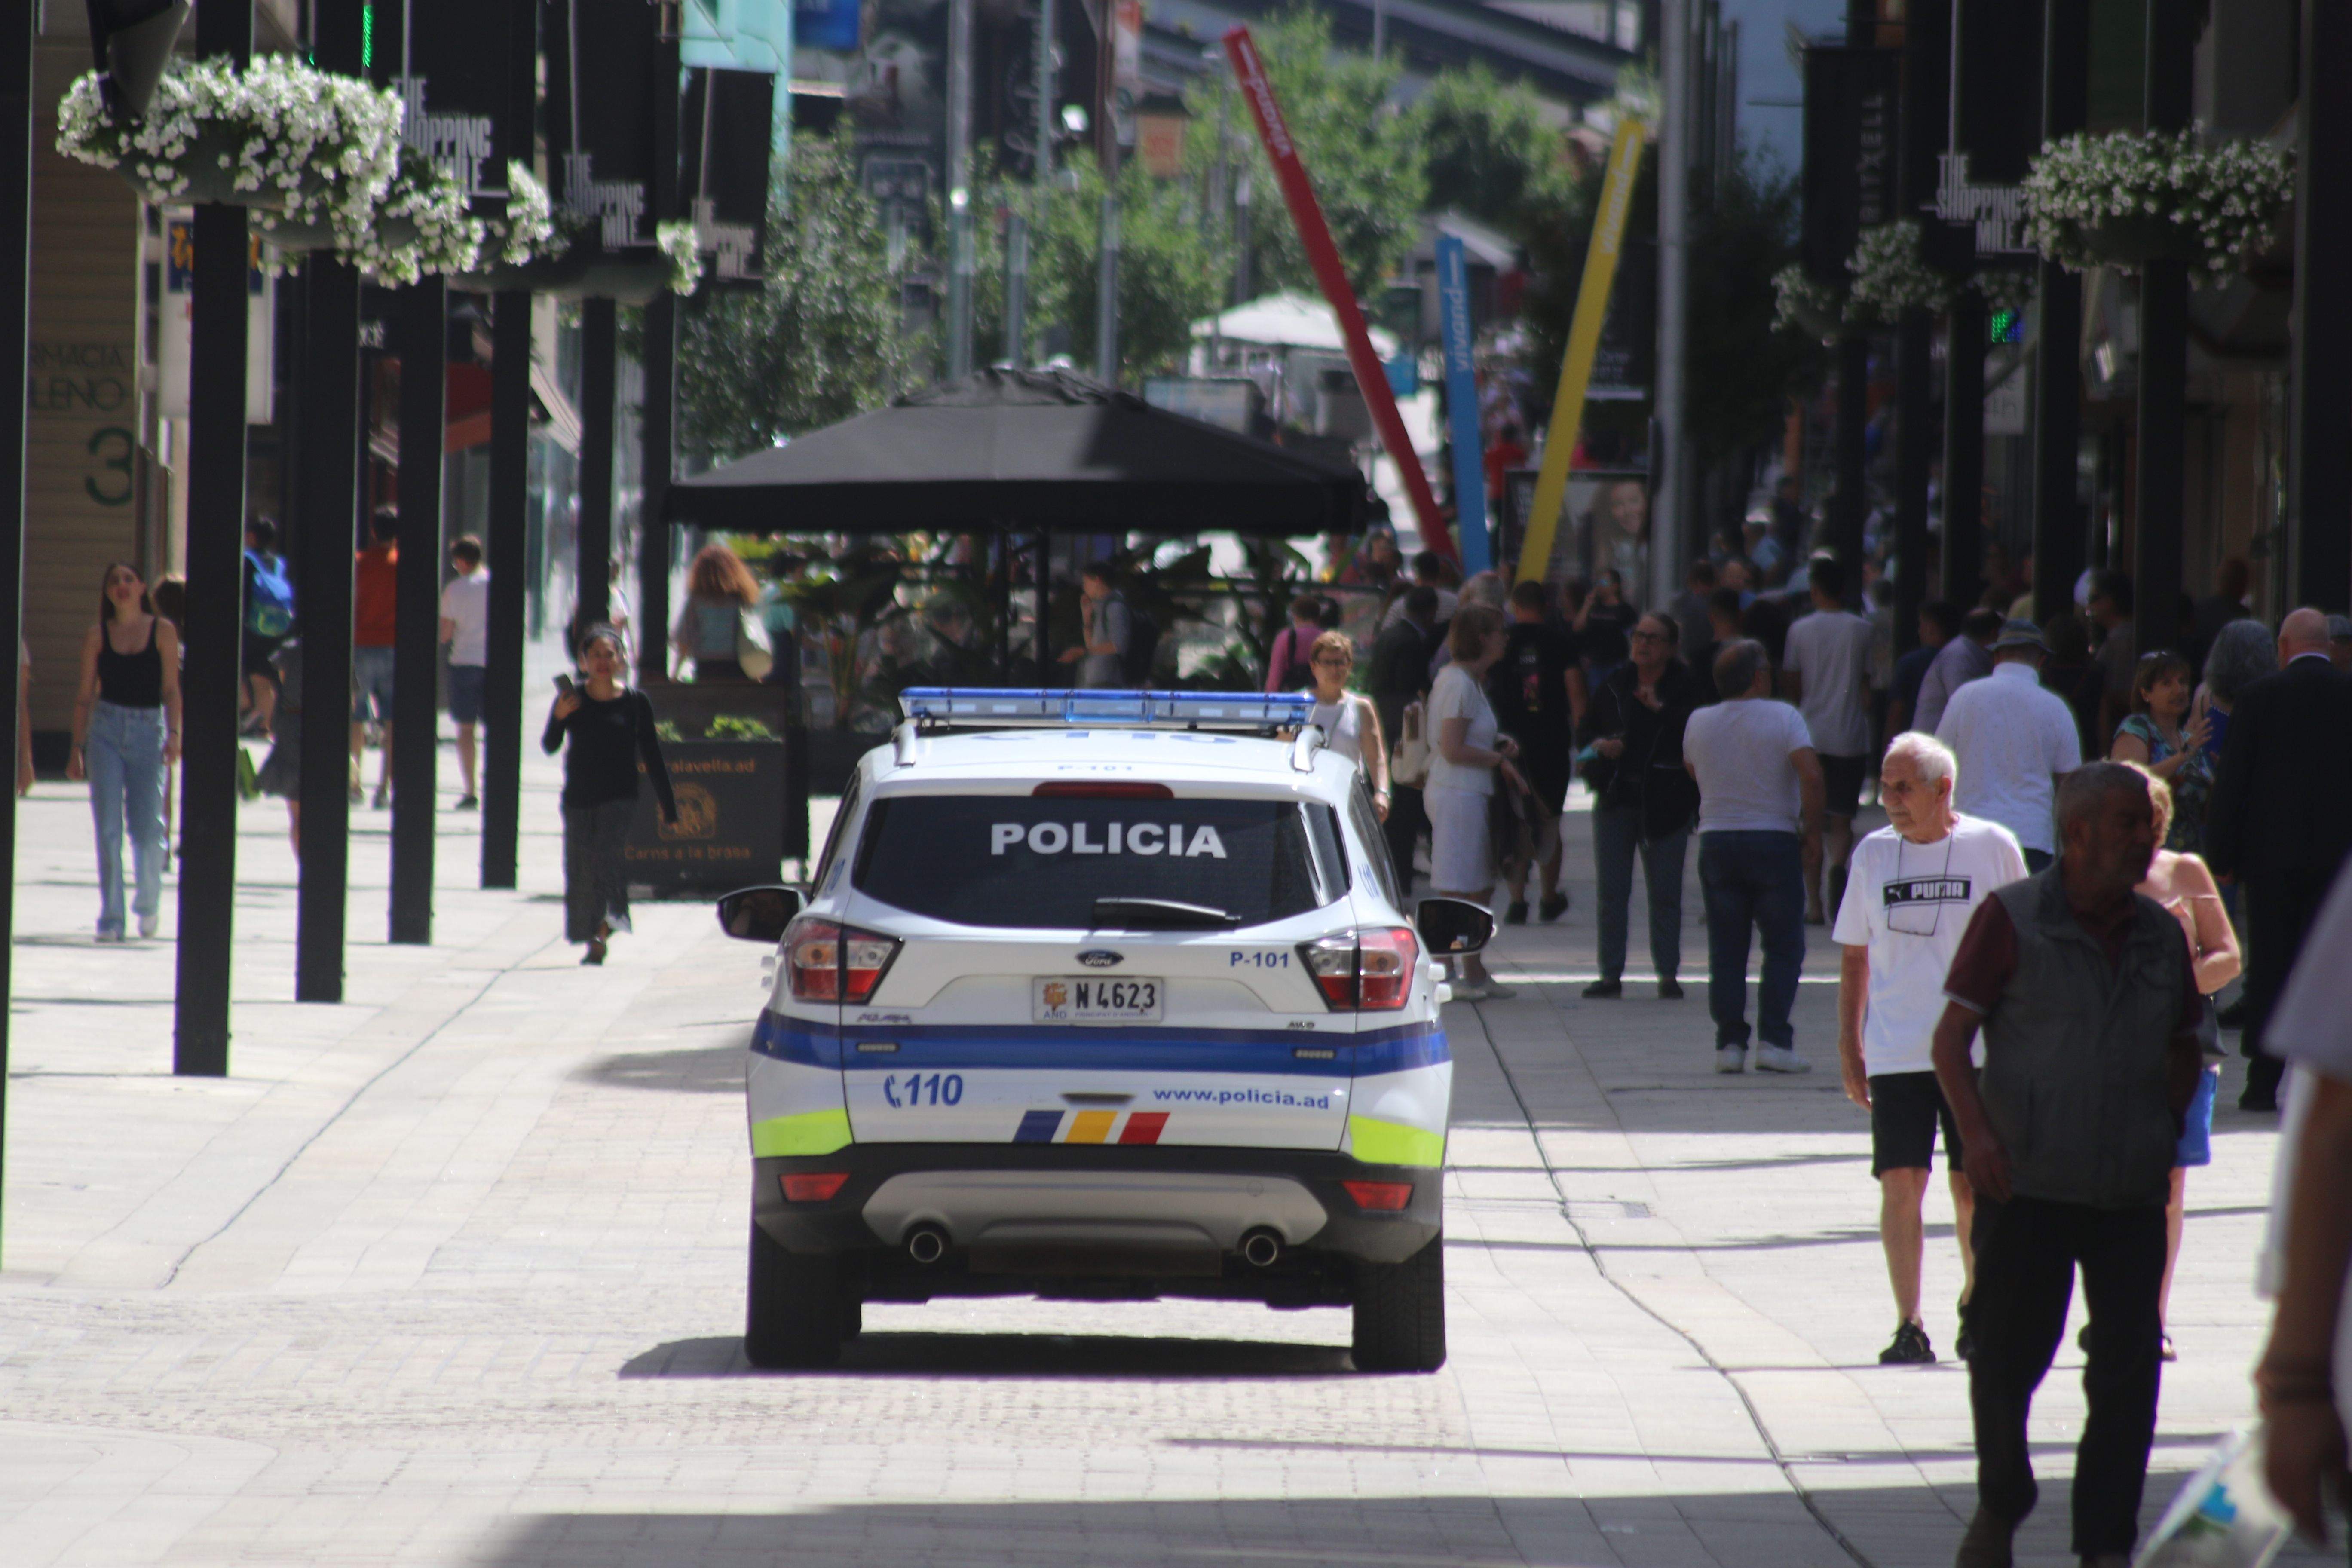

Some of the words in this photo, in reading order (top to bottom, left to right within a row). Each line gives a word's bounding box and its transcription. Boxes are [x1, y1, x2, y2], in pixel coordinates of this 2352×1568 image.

[402, 116, 493, 159] HOPPING
[1937, 156, 1968, 188] THE
[1936, 186, 2022, 221] SHOPPING
[30, 343, 125, 368] RMACIA
[31, 376, 125, 411] LENO
[990, 822, 1226, 859] POLICIA
[1911, 881, 1964, 900] PUMA
[1230, 951, 1288, 968] P-101
[1076, 983, 1088, 1008] N
[1097, 983, 1155, 1009] 4623
[1043, 1011, 1067, 1019] AND
[905, 1074, 963, 1106] 110
[1153, 1087, 1329, 1110] www.policia.ad
